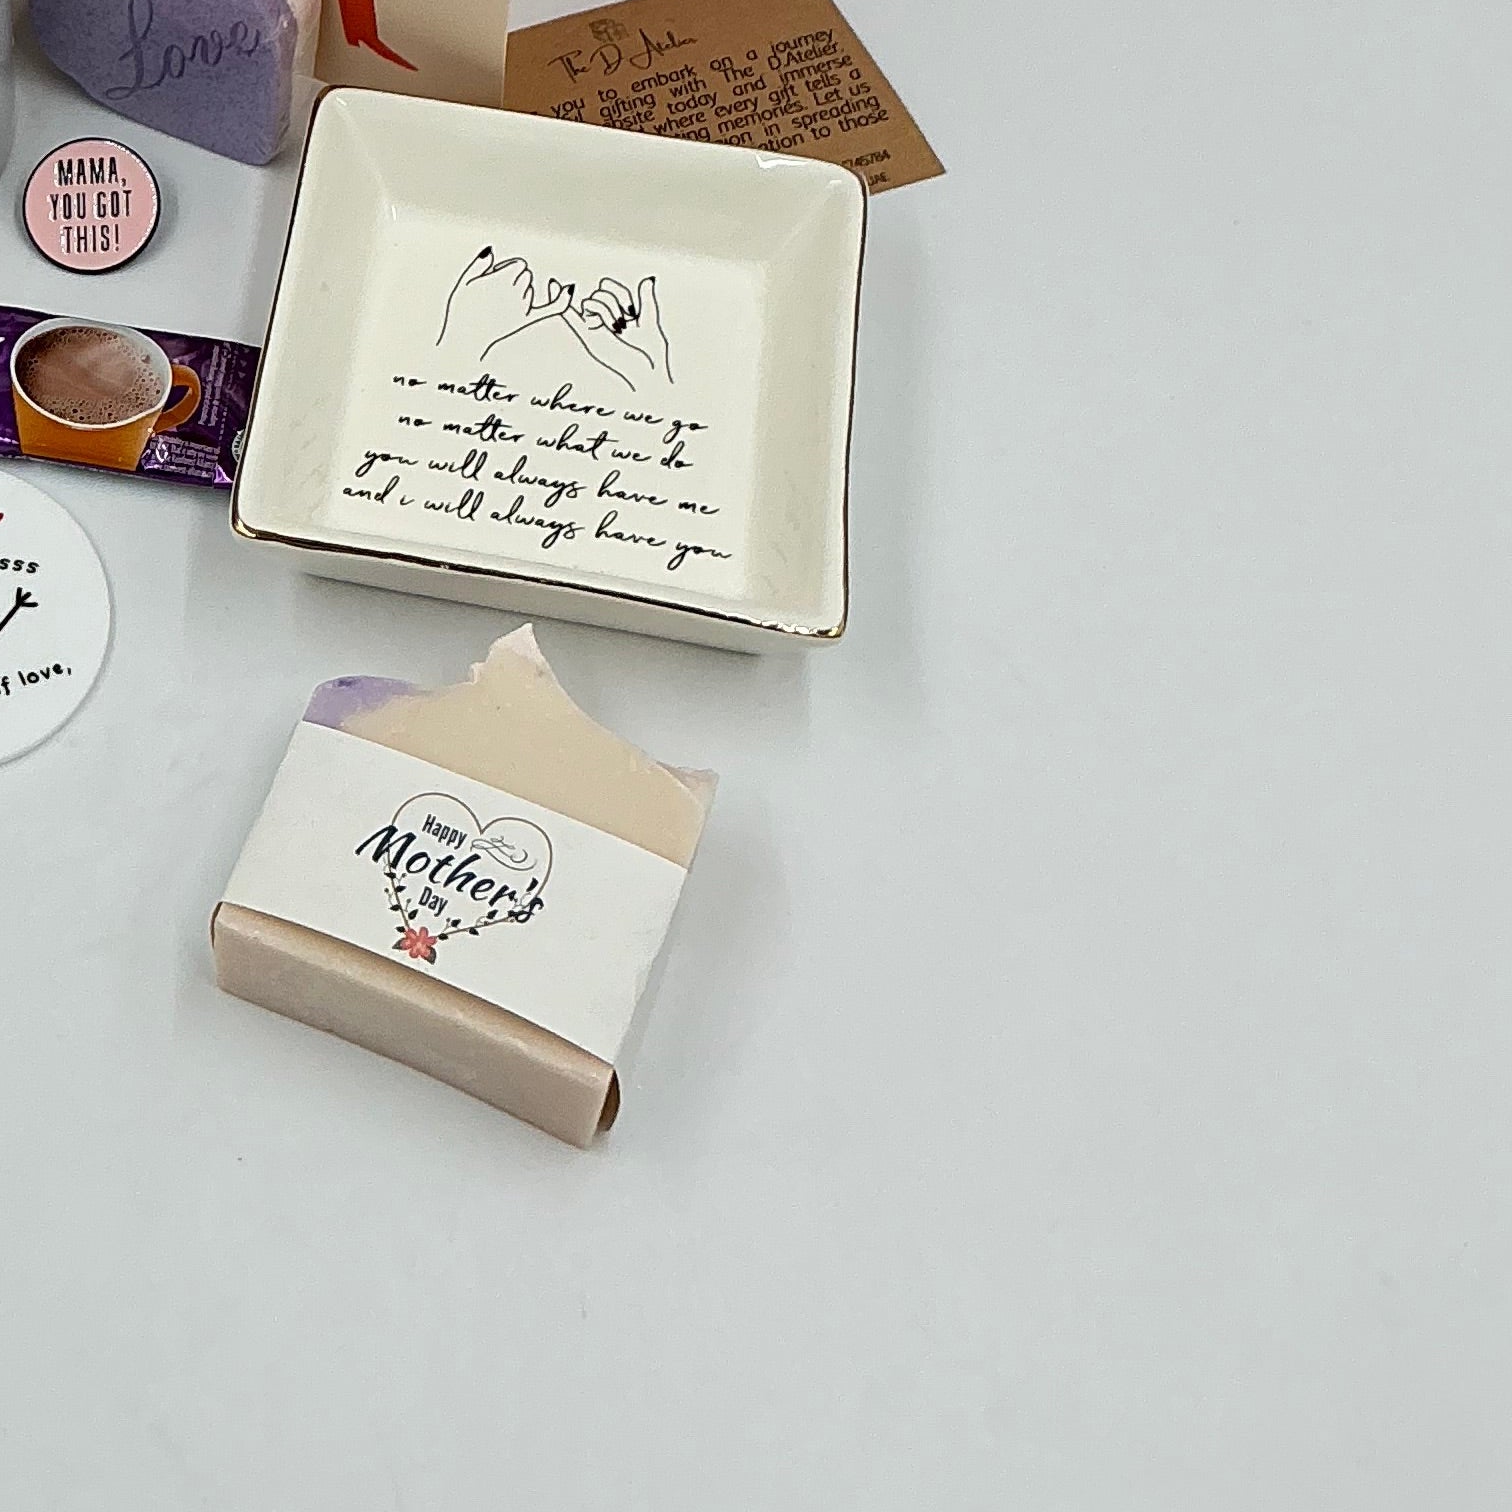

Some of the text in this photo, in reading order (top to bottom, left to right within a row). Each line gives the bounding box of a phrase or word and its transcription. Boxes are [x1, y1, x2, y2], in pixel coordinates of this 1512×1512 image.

[547, 49, 591, 84] The
[590, 43, 624, 77] D
[597, 88, 619, 103] to
[631, 64, 697, 93] embark
[709, 55, 734, 72] on
[745, 49, 759, 62] a
[769, 28, 834, 58] journey
[667, 91, 718, 115] today
[732, 75, 768, 97] and
[778, 54, 854, 86] immerse
[599, 92, 657, 120] gifting
[669, 77, 708, 99] with
[719, 65, 755, 83] The
[654, 111, 707, 134] where
[714, 96, 759, 118] every
[768, 82, 799, 105] gift
[804, 72, 842, 93] tells
[849, 67, 862, 81] a
[717, 99, 809, 134] memories.
[813, 88, 844, 107] Let
[848, 81, 872, 97] us
[763, 122, 782, 137] in
[792, 95, 881, 130] spreading
[811, 125, 831, 140] to
[838, 108, 890, 133] those
[56, 156, 127, 187] MAMA,
[49, 190, 133, 221] YOU GOT
[61, 224, 120, 254] THIS!
[393, 373, 709, 445] no matter where we go
[398, 414, 695, 469] no matter what we do
[355, 446, 720, 516] you will always have me
[342, 475, 402, 506] and
[424, 489, 486, 522] will
[490, 495, 586, 549] always
[594, 510, 668, 548] have
[667, 541, 734, 571] you
[18, 662, 73, 686] love,
[422, 813, 469, 850] Happy
[354, 824, 545, 924] Mother's
[418, 886, 449, 918] Day
